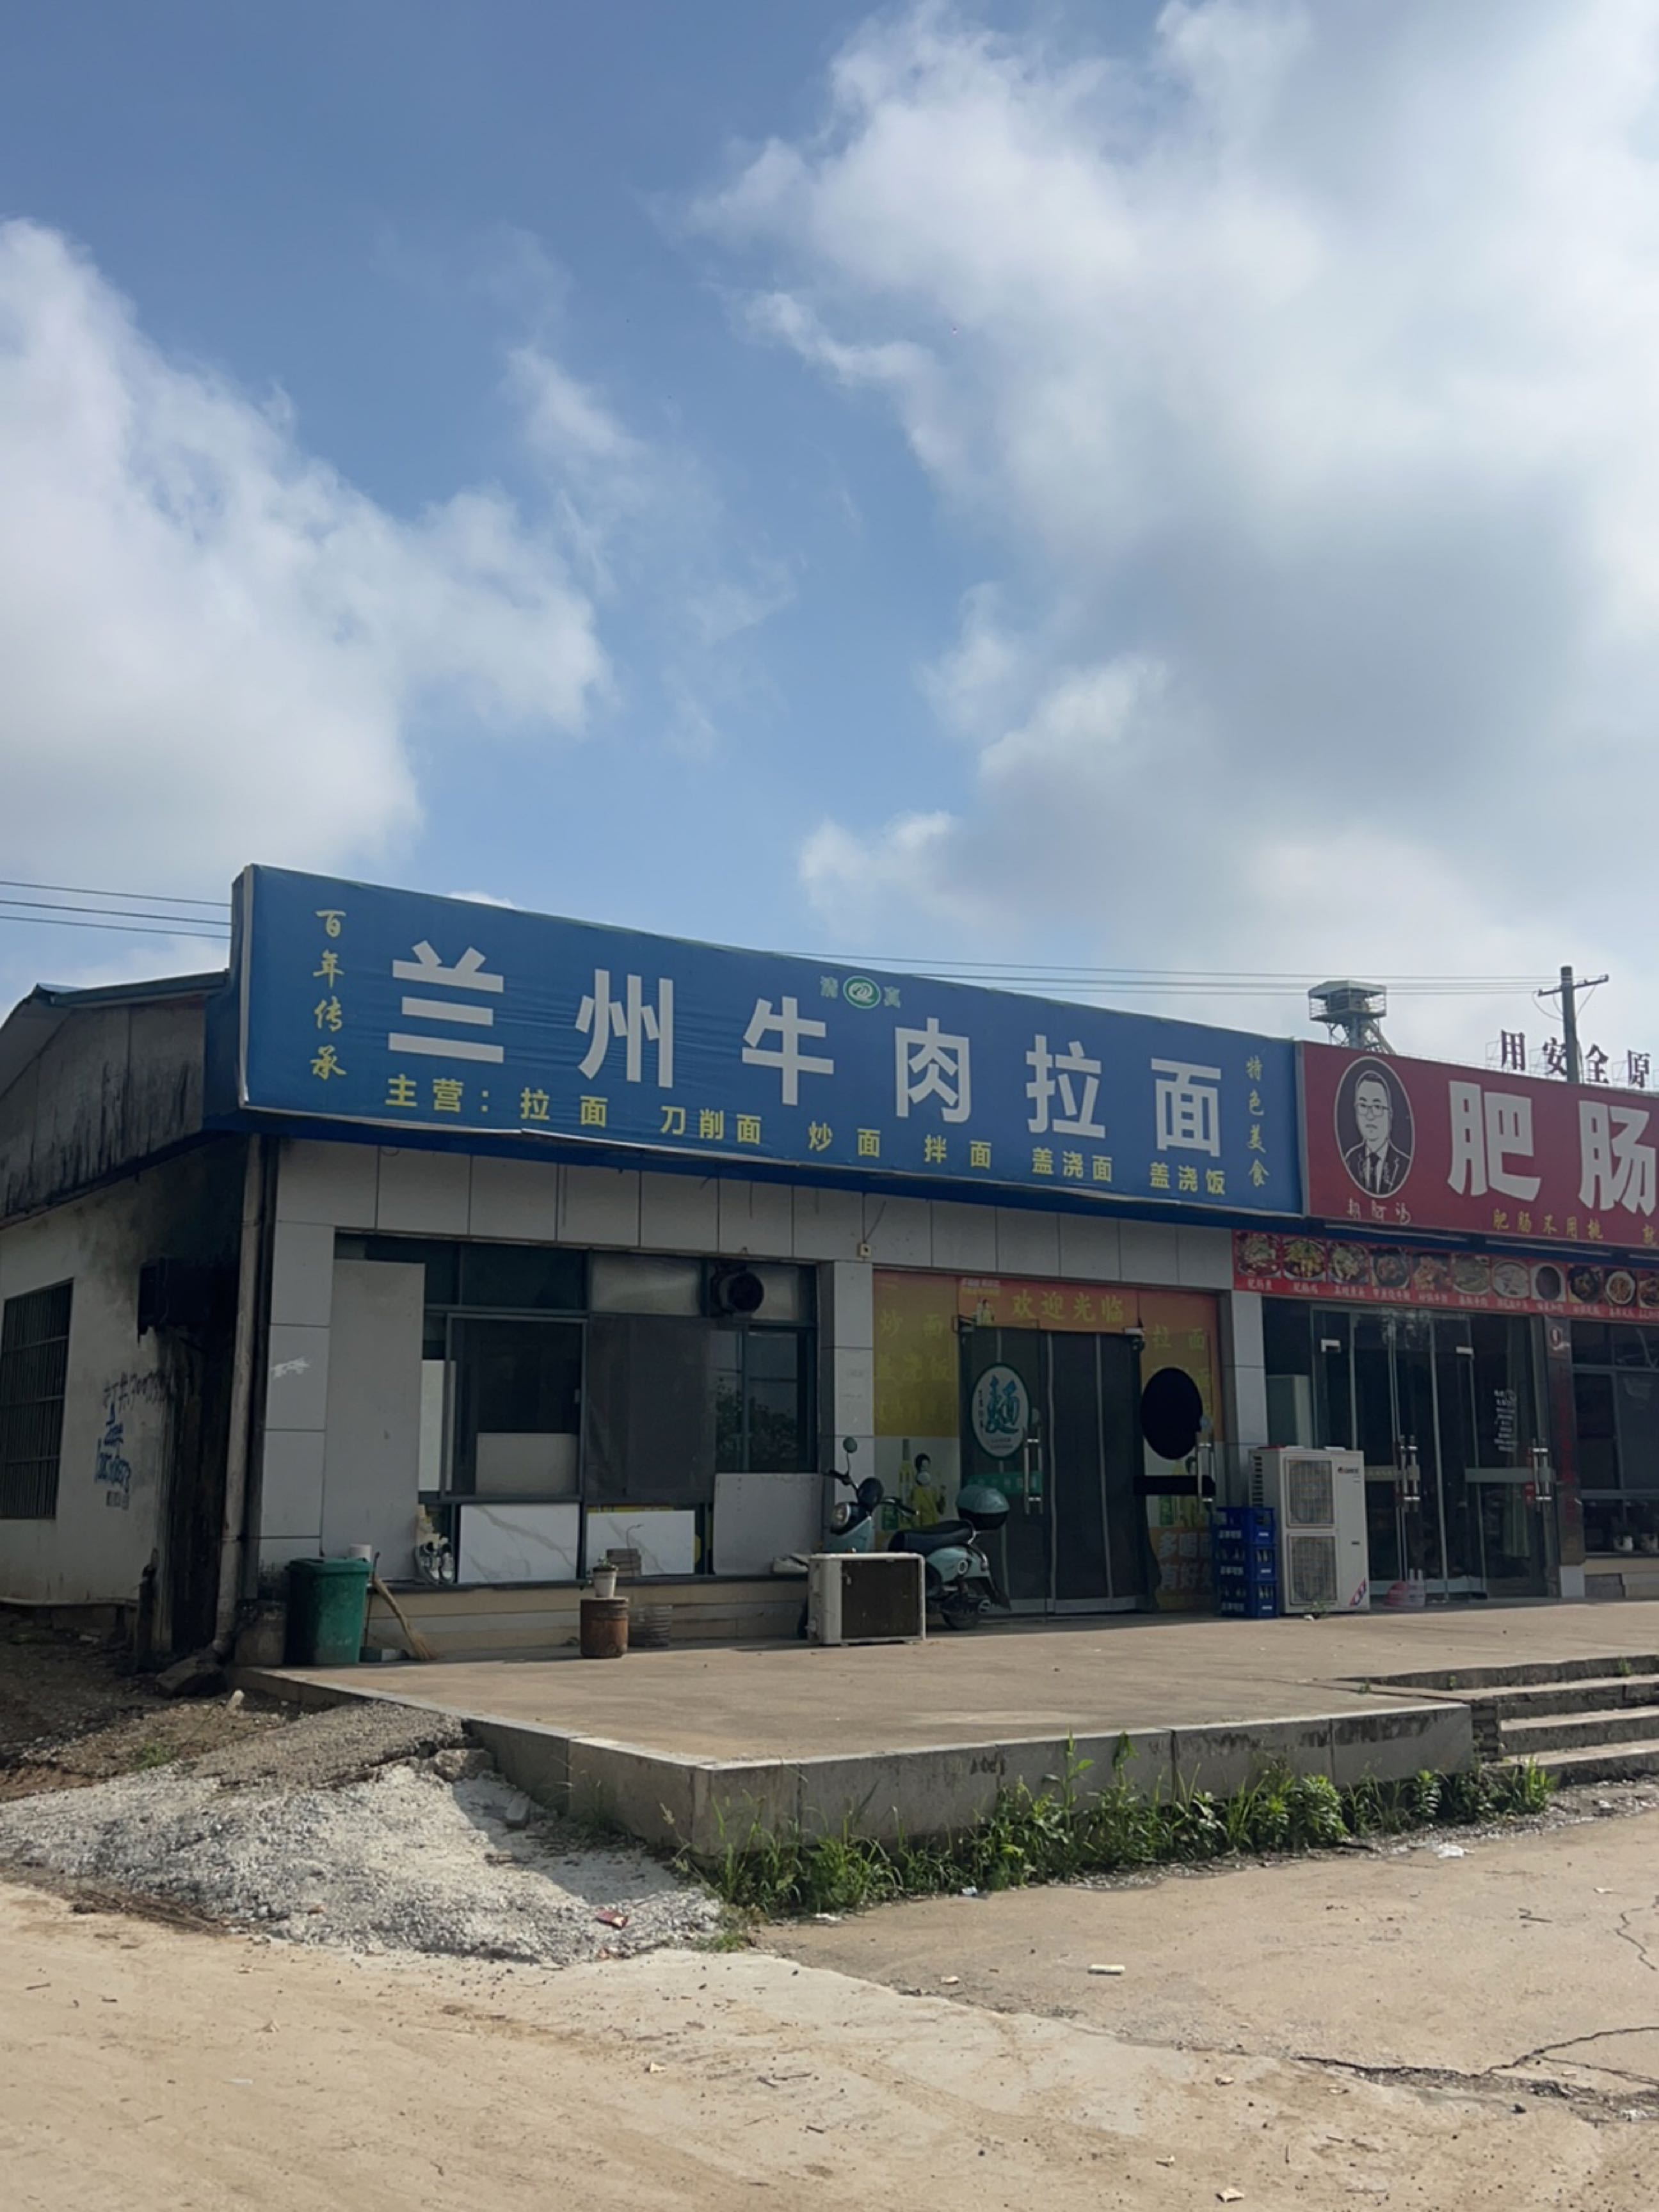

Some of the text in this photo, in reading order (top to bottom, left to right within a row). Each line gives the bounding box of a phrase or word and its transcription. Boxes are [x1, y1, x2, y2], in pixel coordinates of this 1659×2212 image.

[310, 910, 347, 1080] 百年传承
[387, 940, 1222, 1158] 兰州牛肉拉面
[520, 1087, 608, 1128] 拉面
[660, 1105, 762, 1145] 刀削面
[924, 1133, 992, 1170] 拌面
[1031, 1146, 1112, 1183] 盖浇面
[1149, 1161, 1226, 1196] 盖浇饭
[1246, 1055, 1270, 1188] 特色美食
[1447, 1080, 1657, 1217] 肥肠
[1011, 1288, 1125, 1324] 欢迎光临
